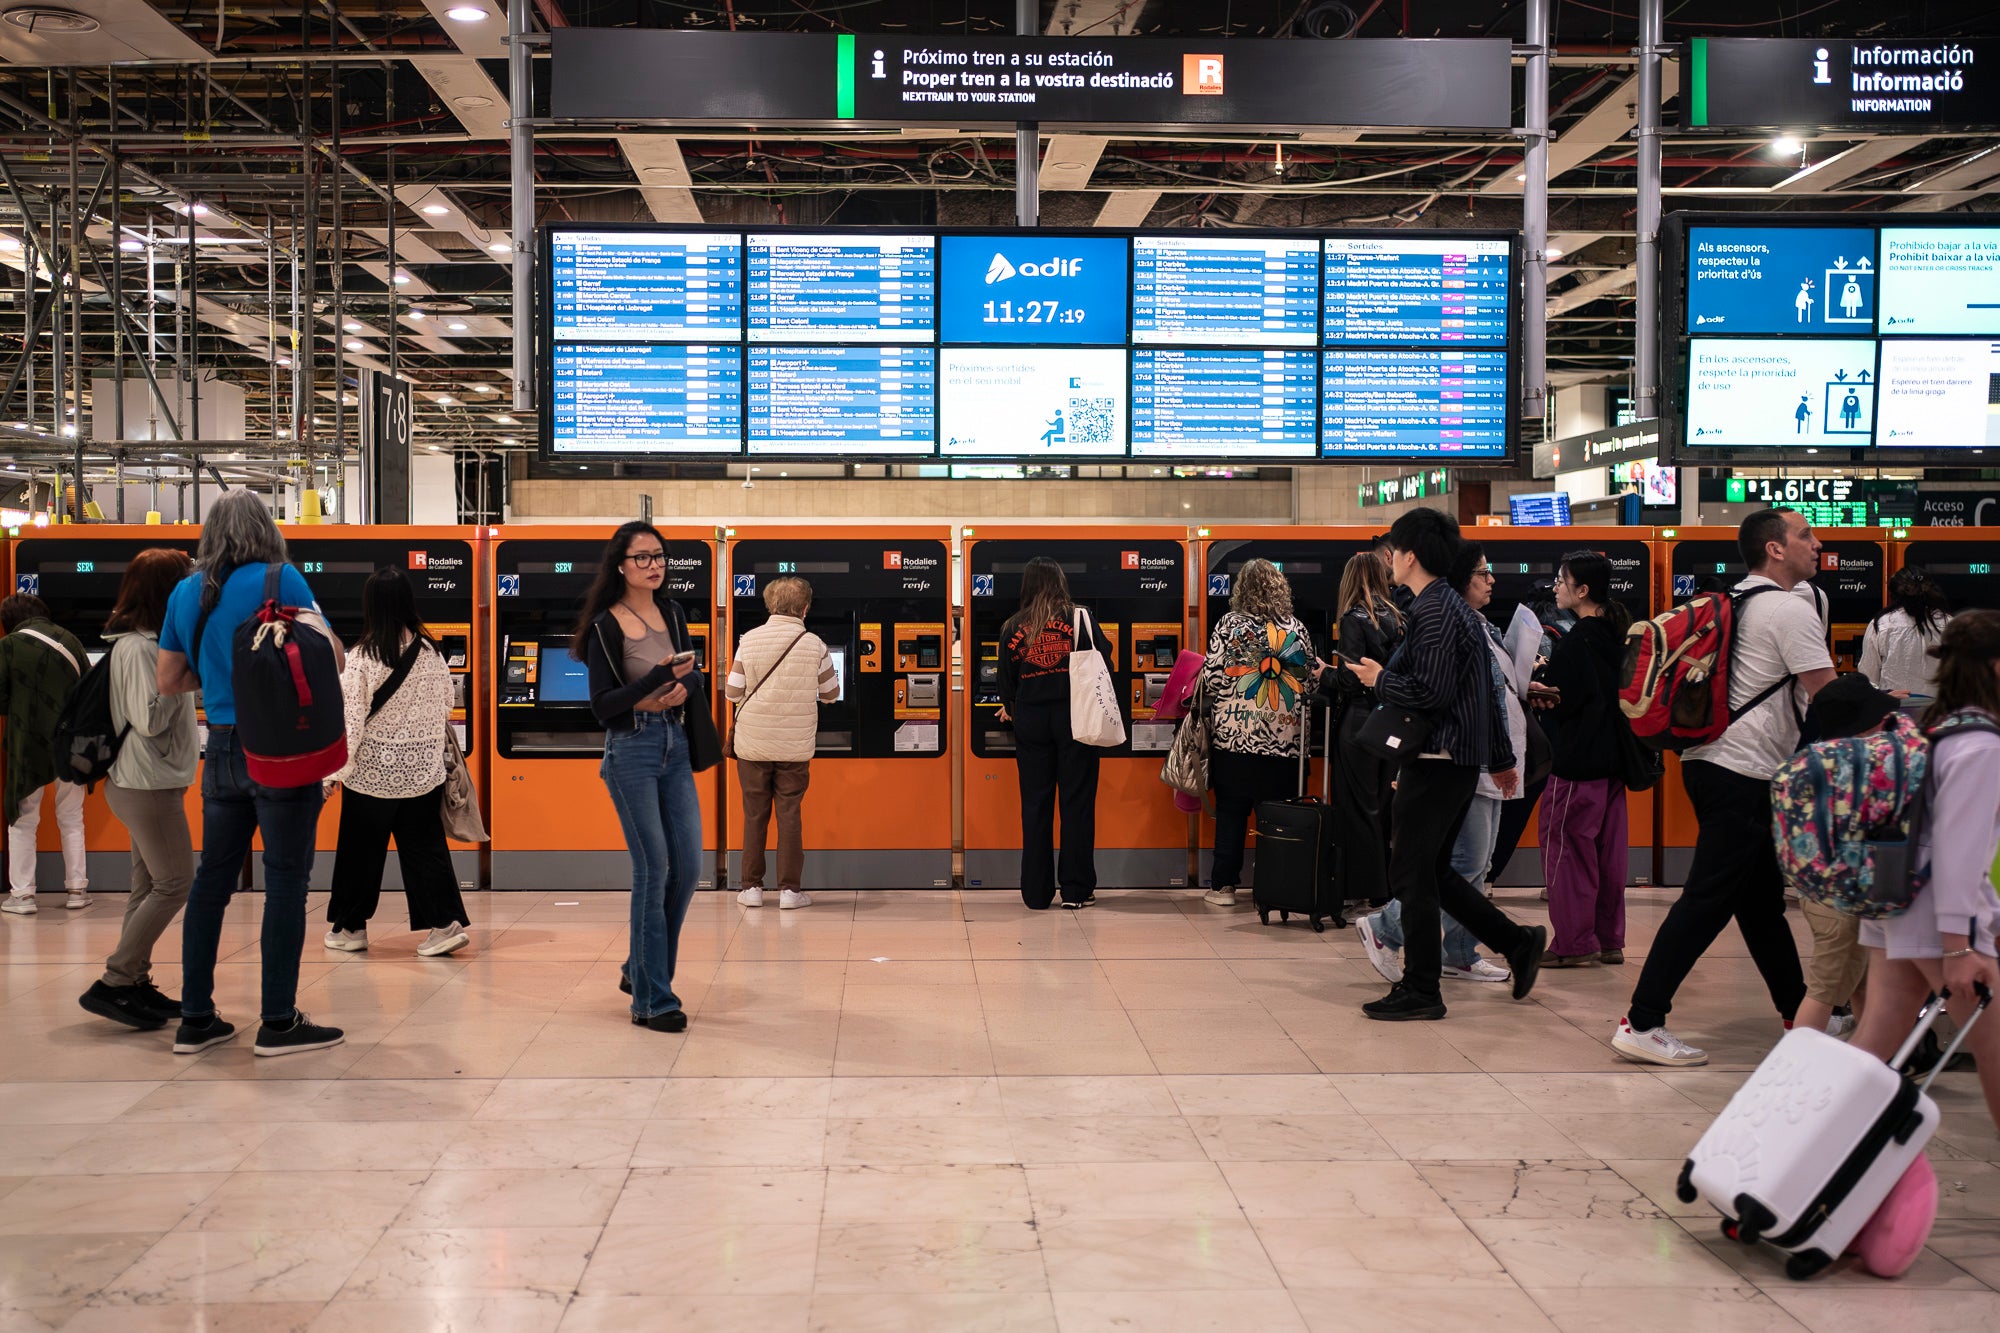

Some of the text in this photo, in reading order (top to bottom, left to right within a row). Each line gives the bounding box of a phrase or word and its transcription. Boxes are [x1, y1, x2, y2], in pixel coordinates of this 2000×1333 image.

[904, 49, 1113, 67] Próximo tren a su estación
[1852, 45, 1974, 65] Información
[1199, 59, 1222, 84] R
[902, 70, 1174, 89] Proper tren a la vostra destinació
[1852, 71, 1964, 91] Informació
[902, 92, 1036, 102] NEXTTRAIN TO YOUR STATION
[1852, 99, 1931, 111] INFORMATION
[1698, 243, 1770, 254] Als ascensors,
[1890, 241, 1935, 250] Prohibido
[1938, 242, 1961, 251] bajar
[1972, 242, 1981, 250] la
[1484, 254, 1488, 262] A
[1498, 254, 1502, 262] 1
[1698, 256, 1760, 267] respecteu la
[1890, 252, 1928, 261] Prohibit
[1932, 253, 1962, 261] baixar
[1975, 253, 1983, 261] la
[1019, 257, 1083, 277] adif
[1698, 270, 1739, 280] prioritat
[617, 304, 624, 312] de
[1699, 354, 1791, 364] En los ascensores,
[1698, 368, 1797, 379] respete la prioridad
[963, 377, 972, 385] el
[1698, 382, 1710, 390] de
[1818, 480, 1830, 500] C
[1924, 500, 1964, 511] Acceso
[1931, 516, 1964, 526] Accés
[416, 554, 426, 565] R
[890, 554, 901, 565] R
[903, 558, 937, 566] Rodalies
[1128, 554, 1138, 565] R
[1828, 555, 1837, 566] R
[304, 562, 313, 572] EN
[428, 580, 456, 591] renfe
[668, 581, 695, 592] renfe
[903, 581, 930, 591] renfe
[1141, 581, 1168, 591] renfe
[1840, 582, 1866, 592] renfe
[1222, 703, 1276, 729] Hippie
